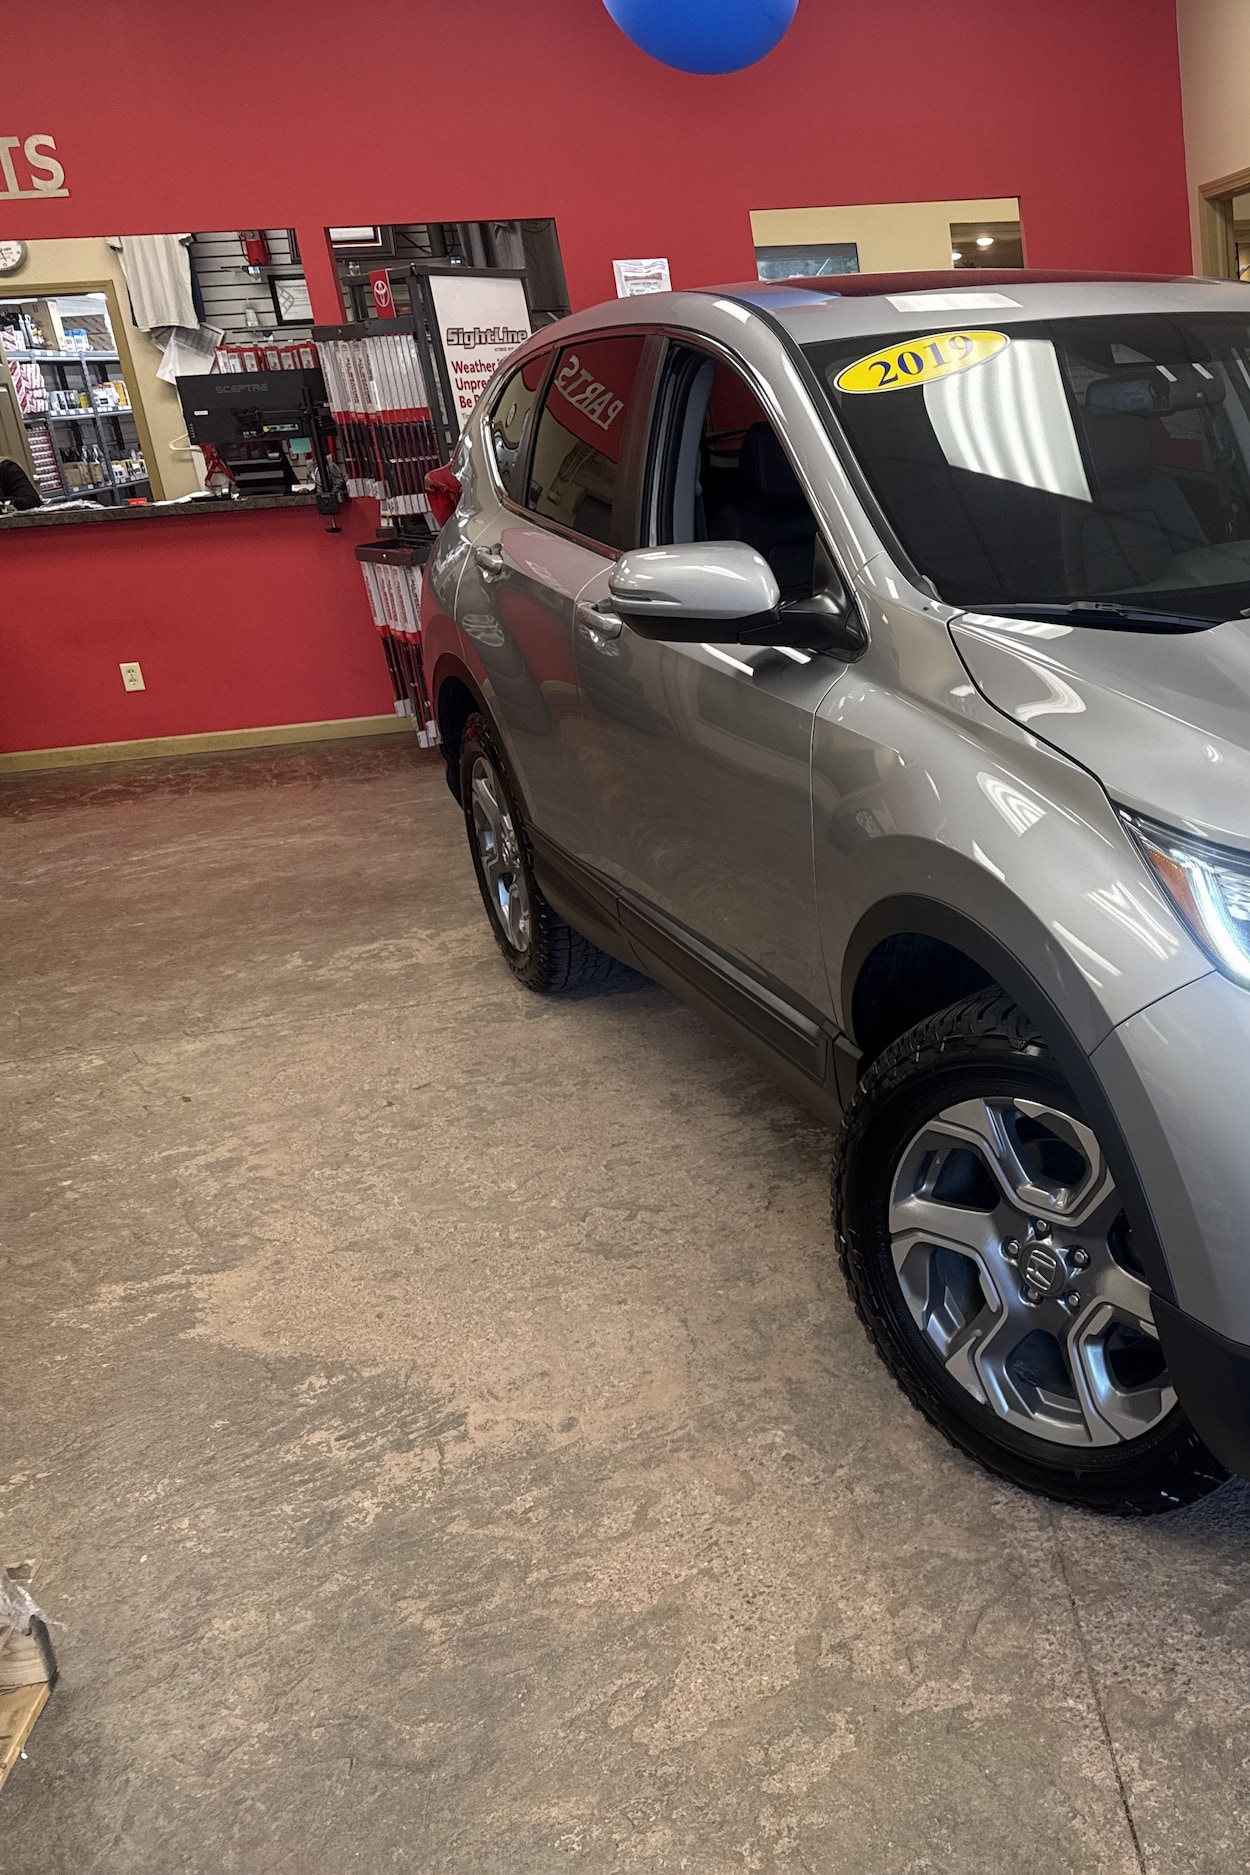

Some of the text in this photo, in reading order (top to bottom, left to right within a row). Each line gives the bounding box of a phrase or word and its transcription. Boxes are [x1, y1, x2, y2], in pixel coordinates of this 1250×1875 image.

[446, 327, 528, 349] SightLine
[451, 360, 496, 374] Weather
[869, 335, 974, 387] 2019
[215, 383, 270, 394] SCEPTRE
[454, 376, 492, 393] Unpre
[459, 396, 472, 408] Be
